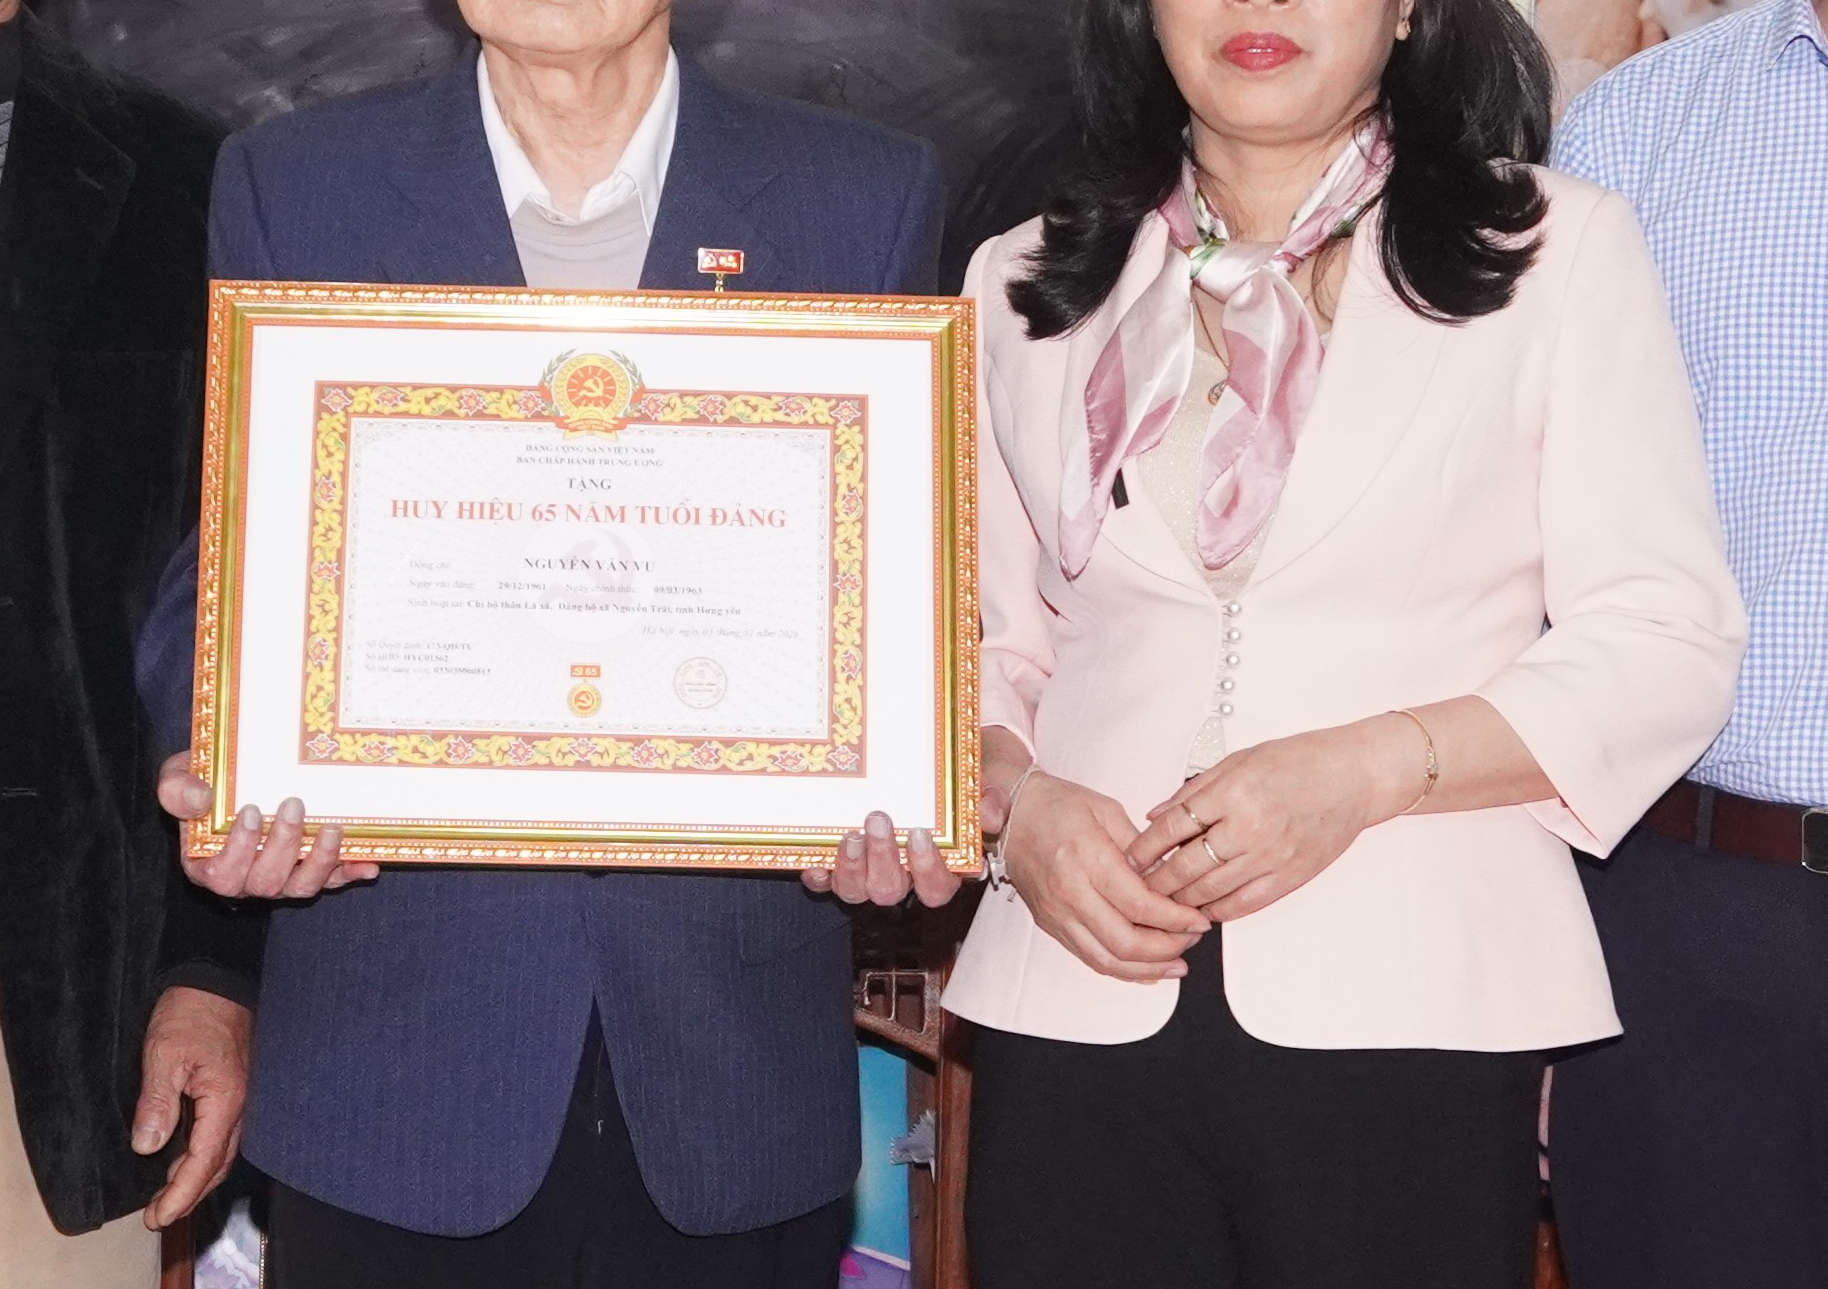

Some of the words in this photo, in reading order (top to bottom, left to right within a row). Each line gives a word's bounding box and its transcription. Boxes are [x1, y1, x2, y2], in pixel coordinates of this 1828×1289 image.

[516, 456, 535, 464] BAN
[566, 477, 612, 492] TẶNG
[390, 498, 448, 519] HUY
[457, 496, 522, 524] HIỆU
[531, 503, 556, 522] 65
[565, 501, 626, 524] NĂM
[635, 498, 700, 526] TUỔI
[708, 506, 788, 528] ĐẢNG
[596, 557, 628, 572] VĂN
